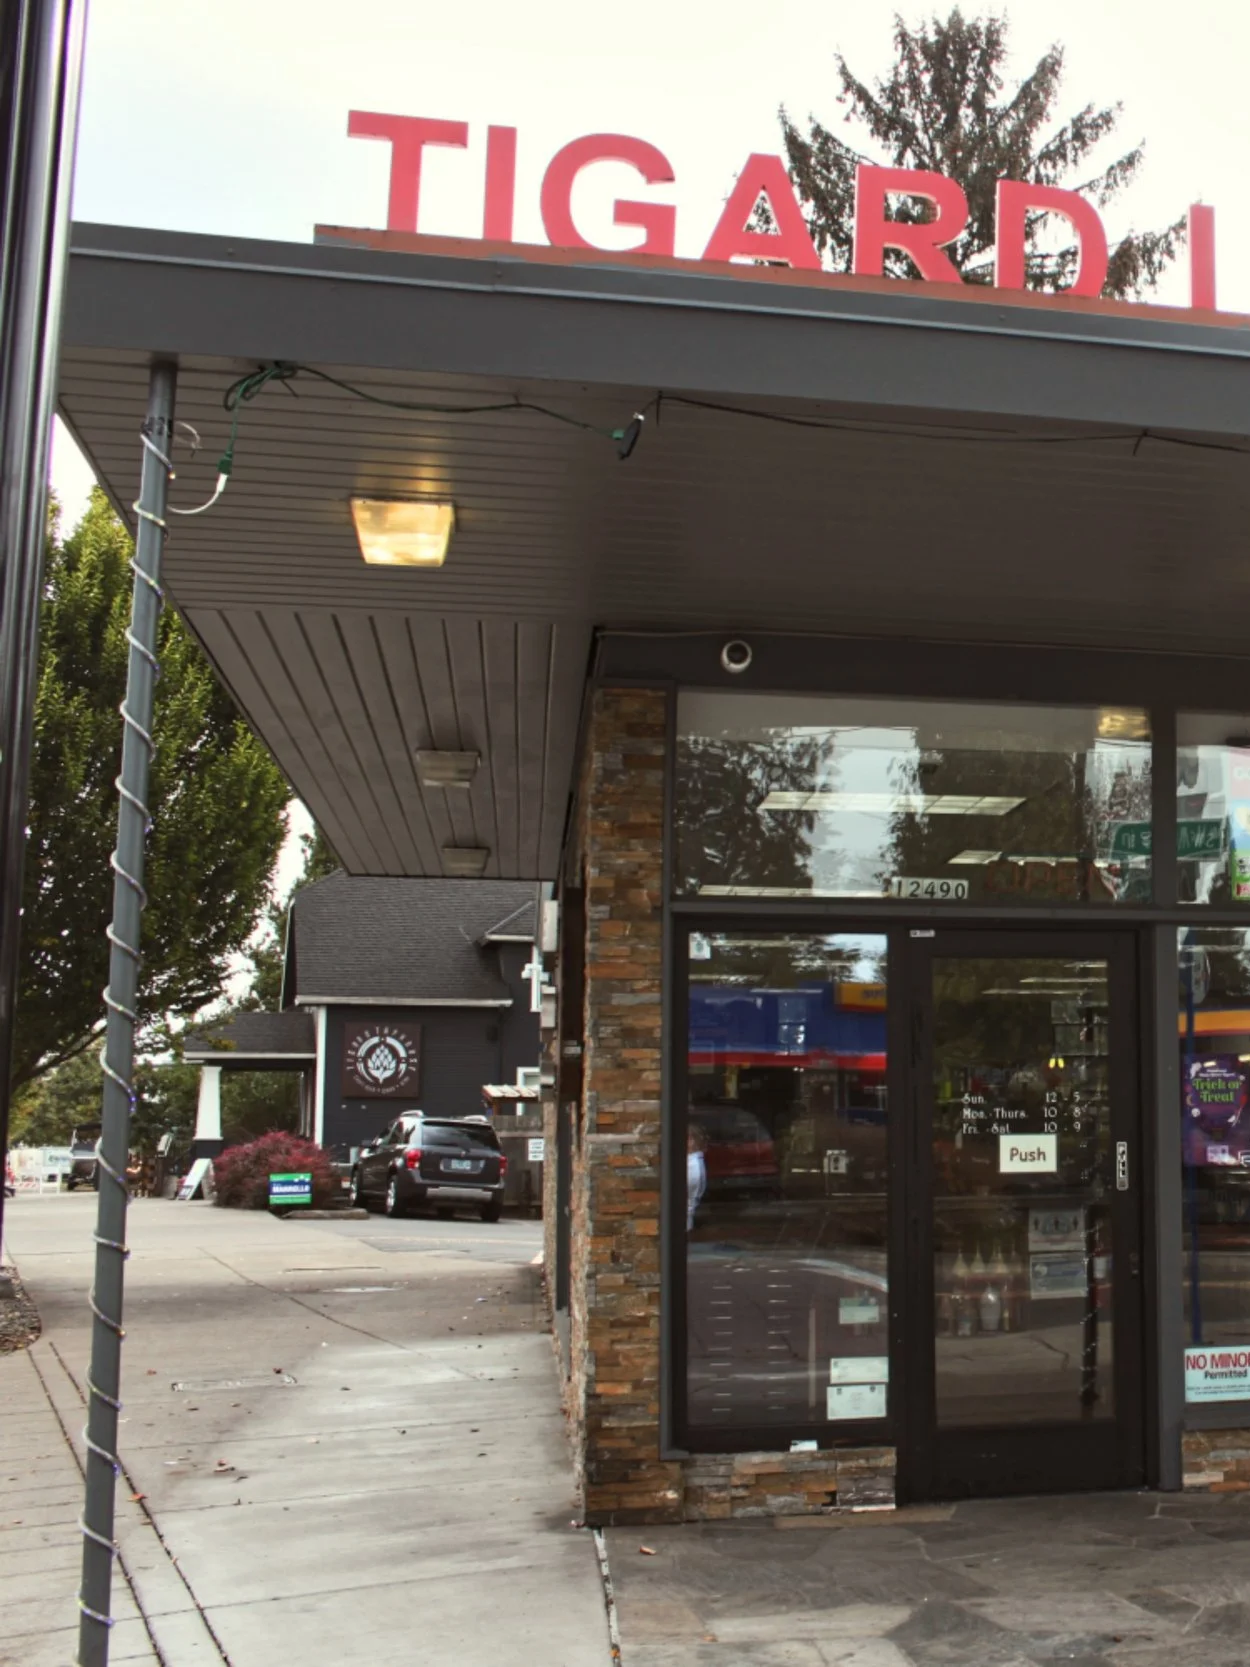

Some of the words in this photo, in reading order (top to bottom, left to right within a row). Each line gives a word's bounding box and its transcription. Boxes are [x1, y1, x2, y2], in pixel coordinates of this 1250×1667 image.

[348, 110, 1109, 297] TIGARD
[897, 880, 966, 900] 12490
[1193, 1078, 1227, 1090] Trick
[1228, 1080, 1241, 1090] or
[1045, 1091, 1058, 1103] 12
[1072, 1091, 1080, 1103] 5
[1201, 1091, 1235, 1103] Treat
[1044, 1106, 1058, 1118] 10
[1072, 1106, 1081, 1118] 8
[1044, 1121, 1058, 1133] 10
[1073, 1121, 1081, 1133] 9
[1009, 1147, 1047, 1162] Push
[1186, 1354, 1207, 1371] NO
[1204, 1368, 1248, 1380] Permitted
